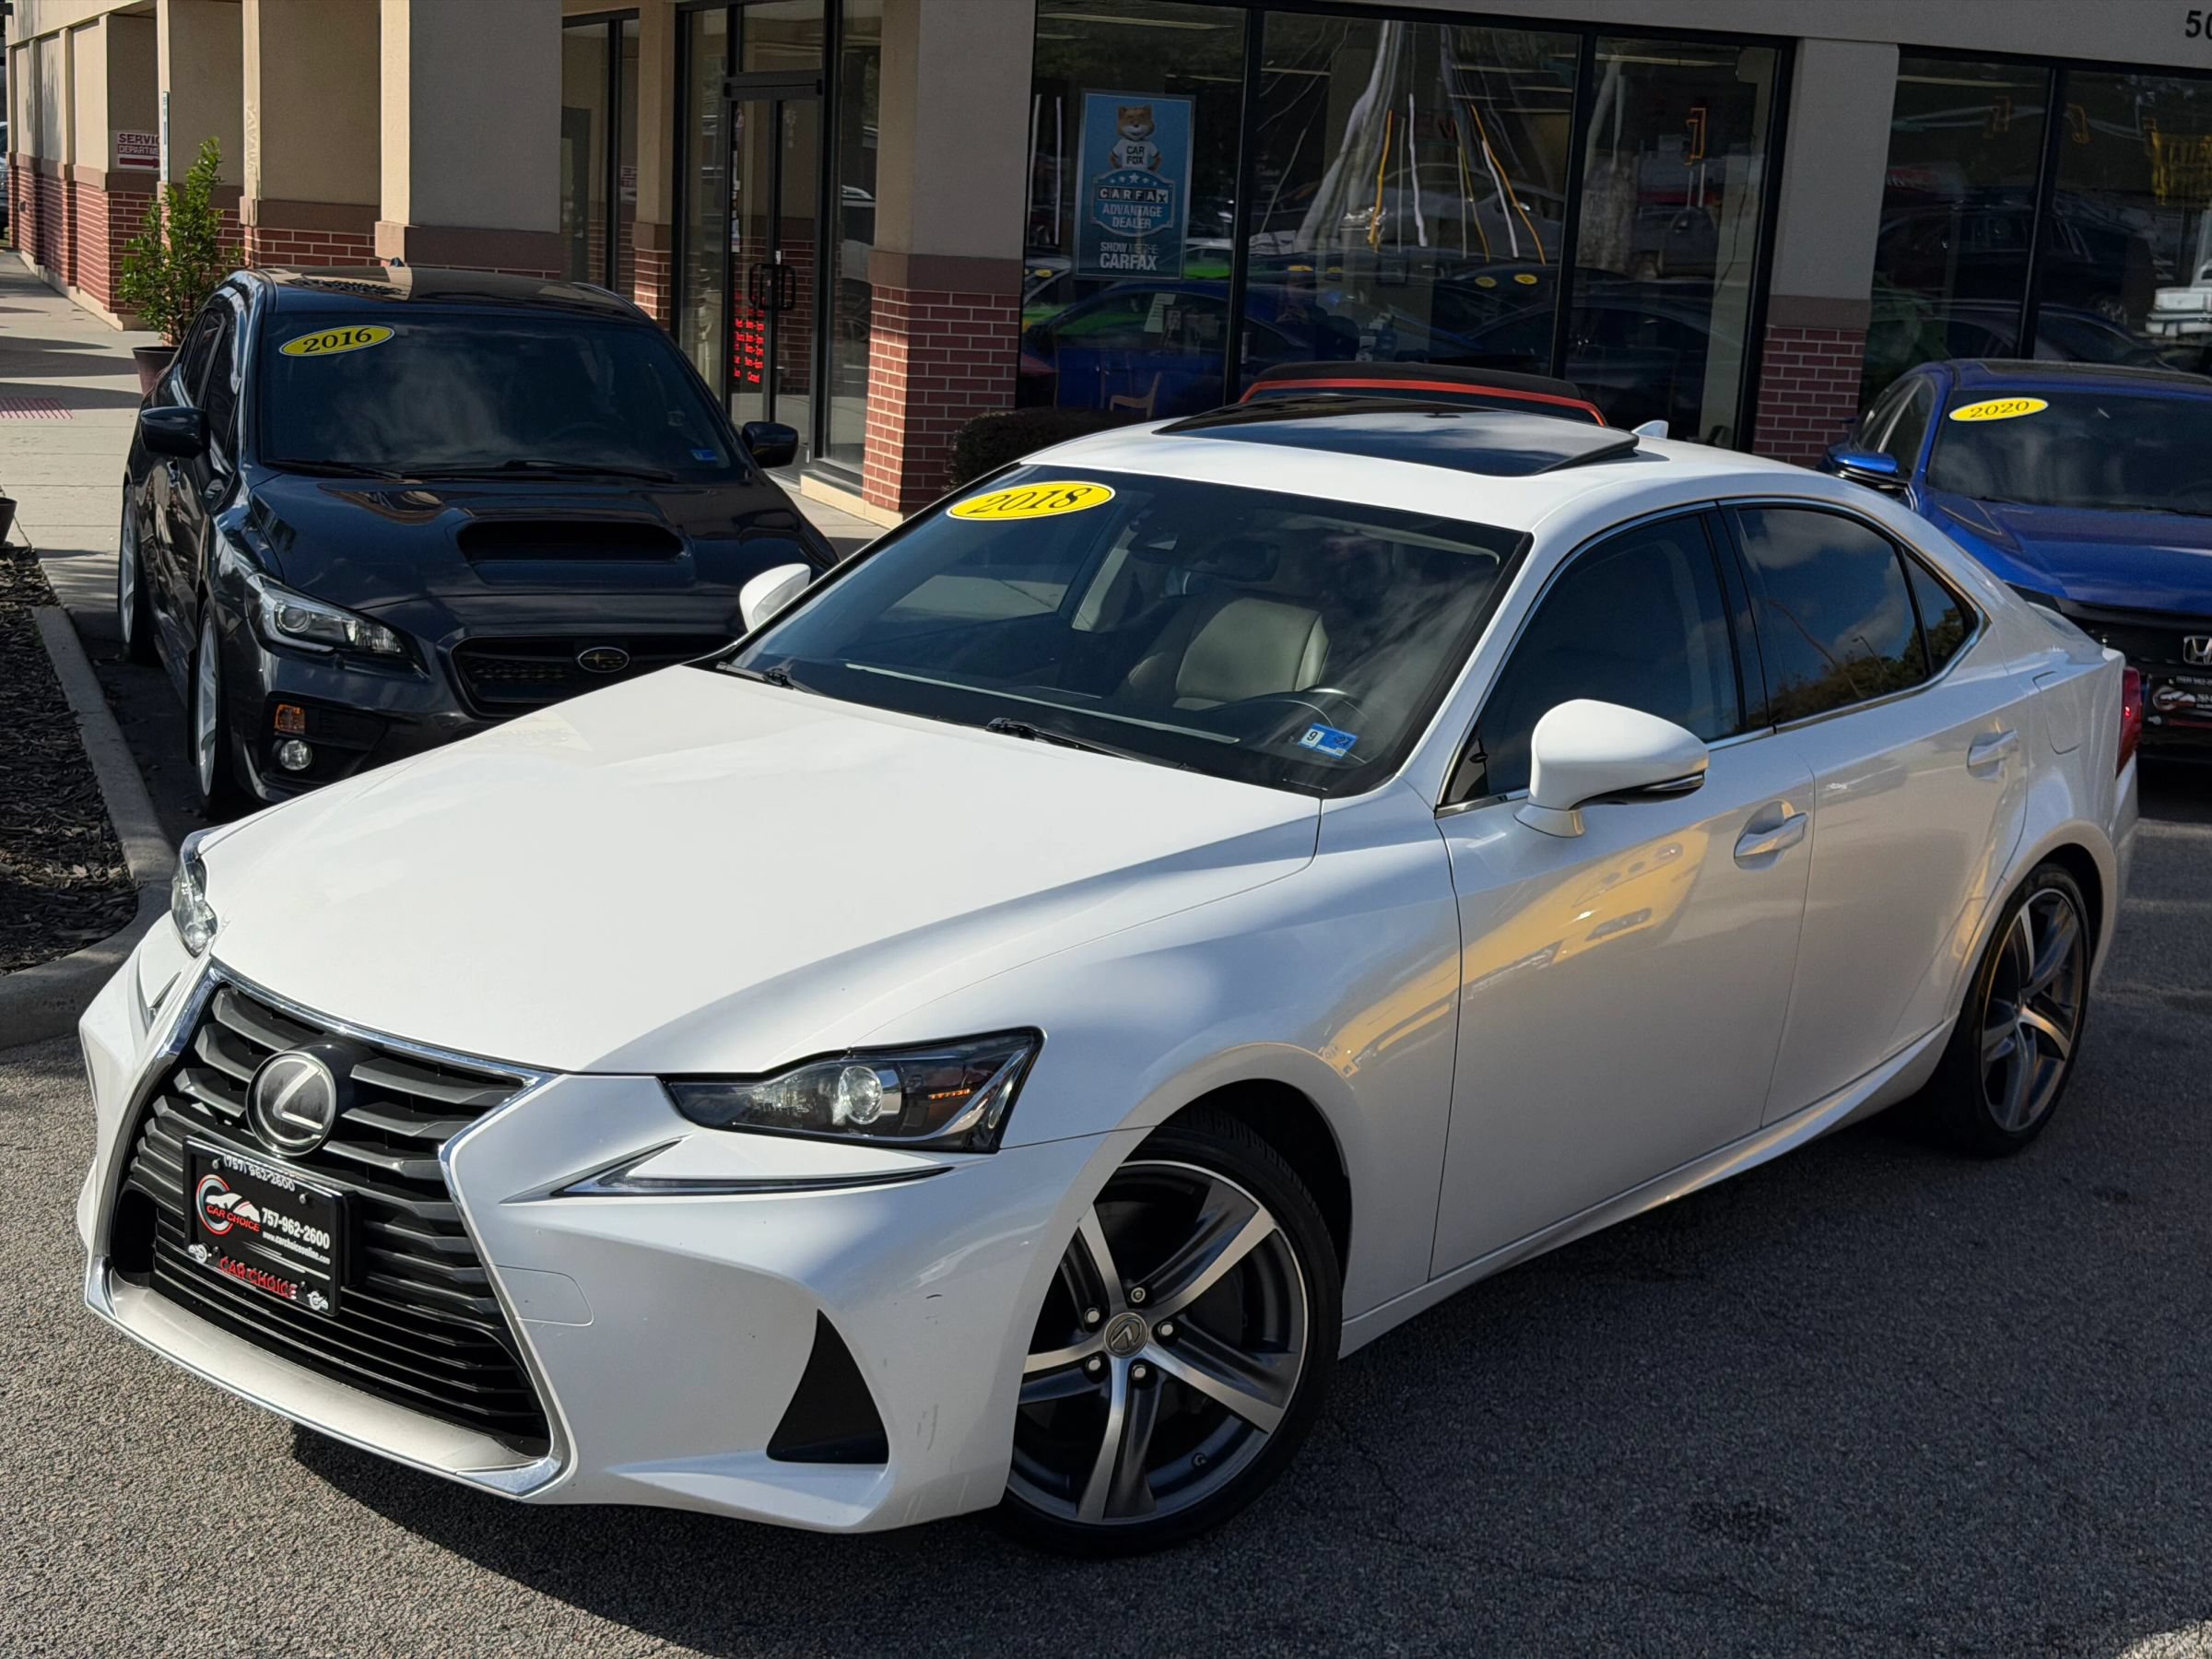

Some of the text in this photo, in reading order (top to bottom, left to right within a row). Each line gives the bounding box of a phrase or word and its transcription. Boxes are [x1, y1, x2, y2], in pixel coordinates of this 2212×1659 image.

[1126, 146, 1145, 155] CAR
[1126, 156, 1144, 165] FOX
[1100, 187, 1168, 203] CARFAX
[1101, 204, 1163, 218] ADVANTAGE
[1112, 217, 1151, 229] DEALER
[1100, 241, 1127, 253] SHOW
[1100, 253, 1159, 271] CARFAX
[302, 327, 372, 353] 2016
[1970, 401, 2030, 418] 2020
[966, 488, 1092, 514] 2018
[1307, 731, 1318, 741] 9
[248, 1164, 296, 1192] 962-2600
[206, 1205, 261, 1232] CAR CHOICE
[262, 1207, 331, 1250] 757-962-2600
[219, 1256, 298, 1300] CAR CHOICE
